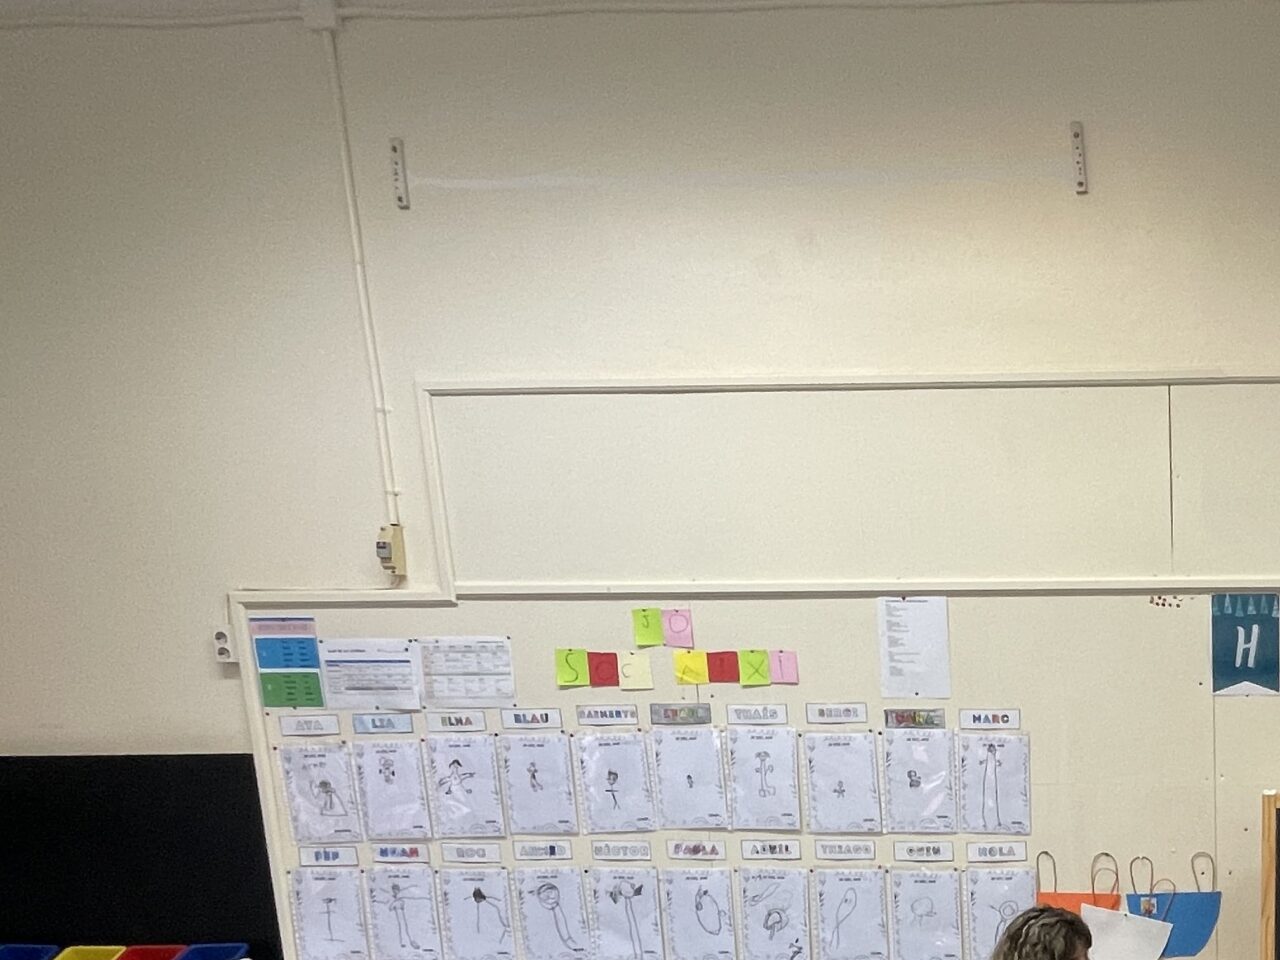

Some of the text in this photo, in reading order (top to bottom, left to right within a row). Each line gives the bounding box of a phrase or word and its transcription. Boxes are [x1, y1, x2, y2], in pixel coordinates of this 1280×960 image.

[371, 718, 395, 729] LIA
[514, 713, 549, 723] BLAU
[972, 713, 1010, 724] MARC
[821, 844, 872, 855] THIAGO
